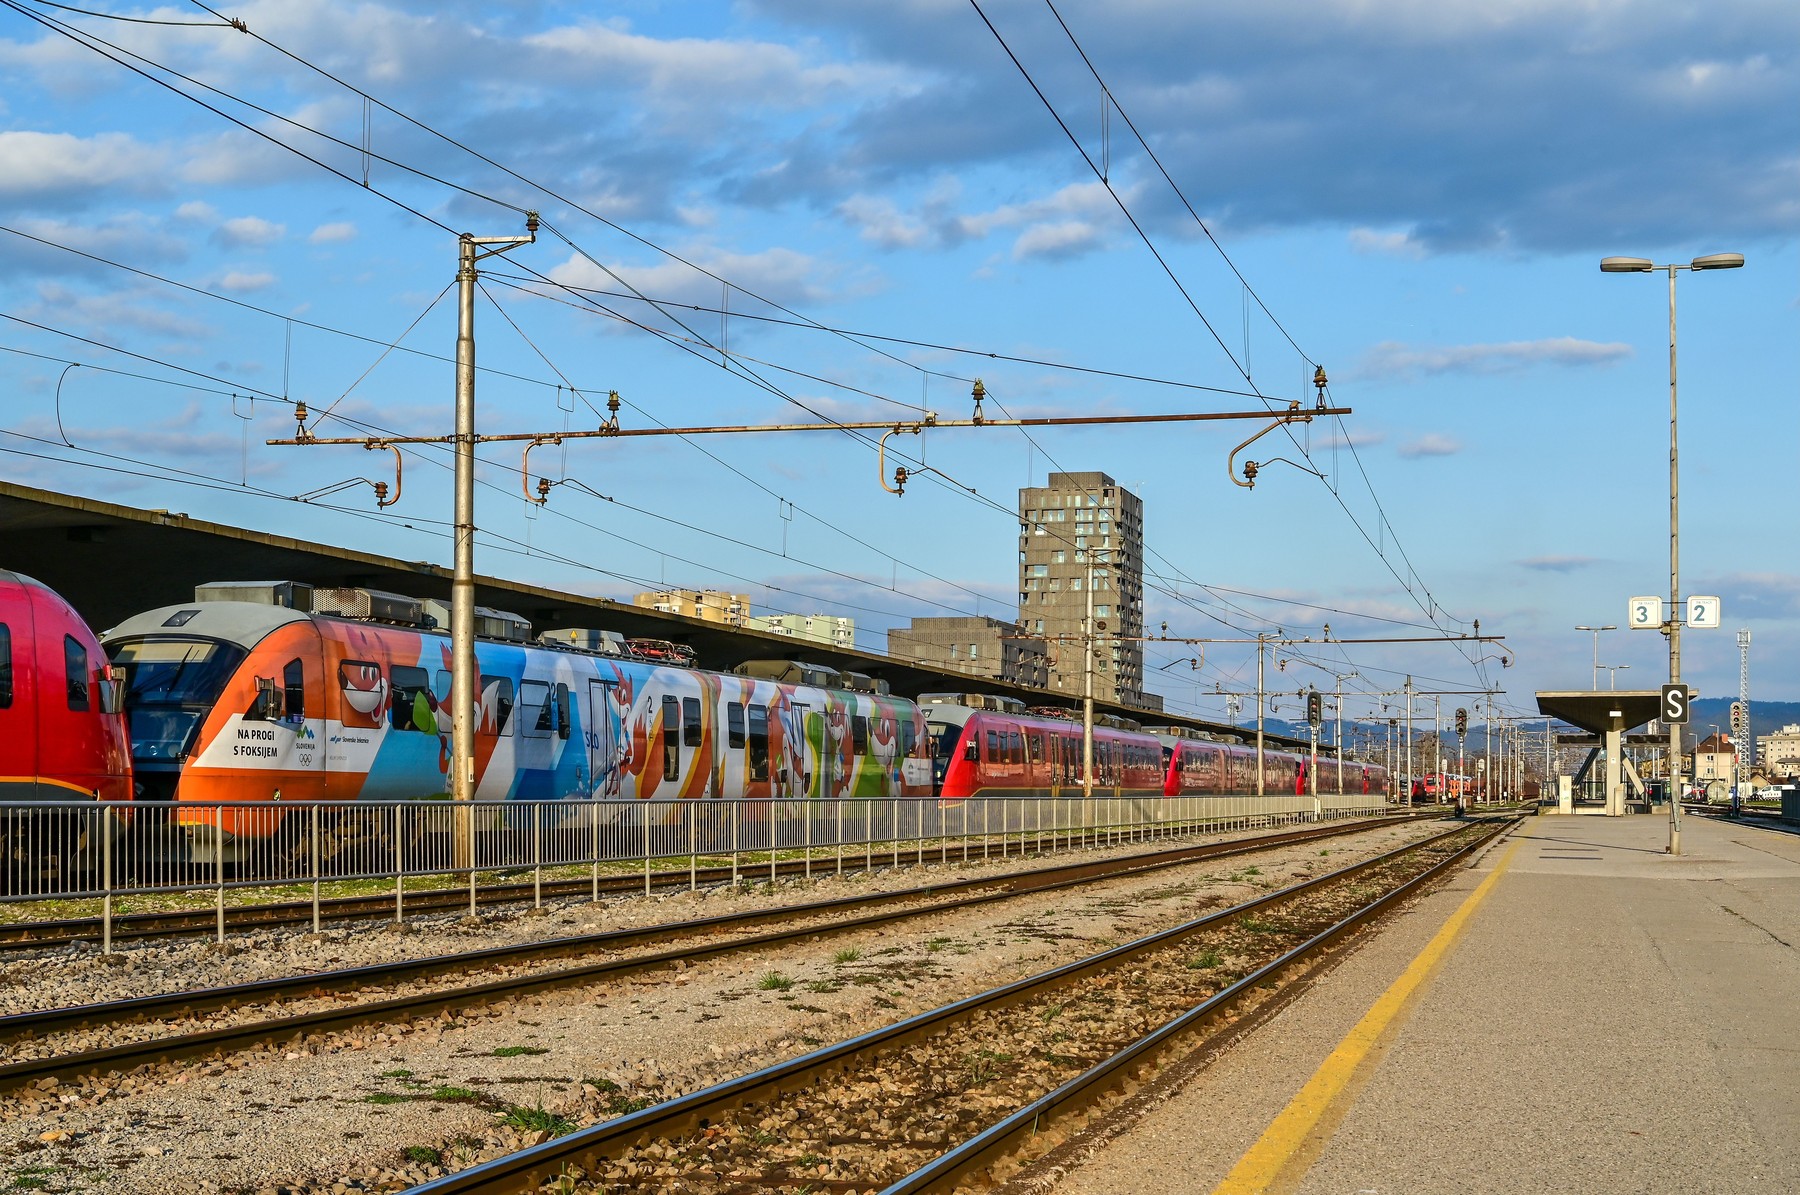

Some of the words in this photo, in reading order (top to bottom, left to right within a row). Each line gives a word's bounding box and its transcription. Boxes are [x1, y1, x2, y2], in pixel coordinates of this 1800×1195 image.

[1636, 605, 1648, 623] 3
[1693, 604, 1705, 621] 2
[550, 682, 556, 702] 2
[647, 695, 653, 714] 2
[1667, 689, 1683, 718] S
[237, 729, 250, 740] NA
[251, 729, 275, 741] PROGI
[233, 745, 239, 756] S
[240, 746, 278, 759] FOKSIJEM
[295, 742, 316, 751] SLOVENIJA
